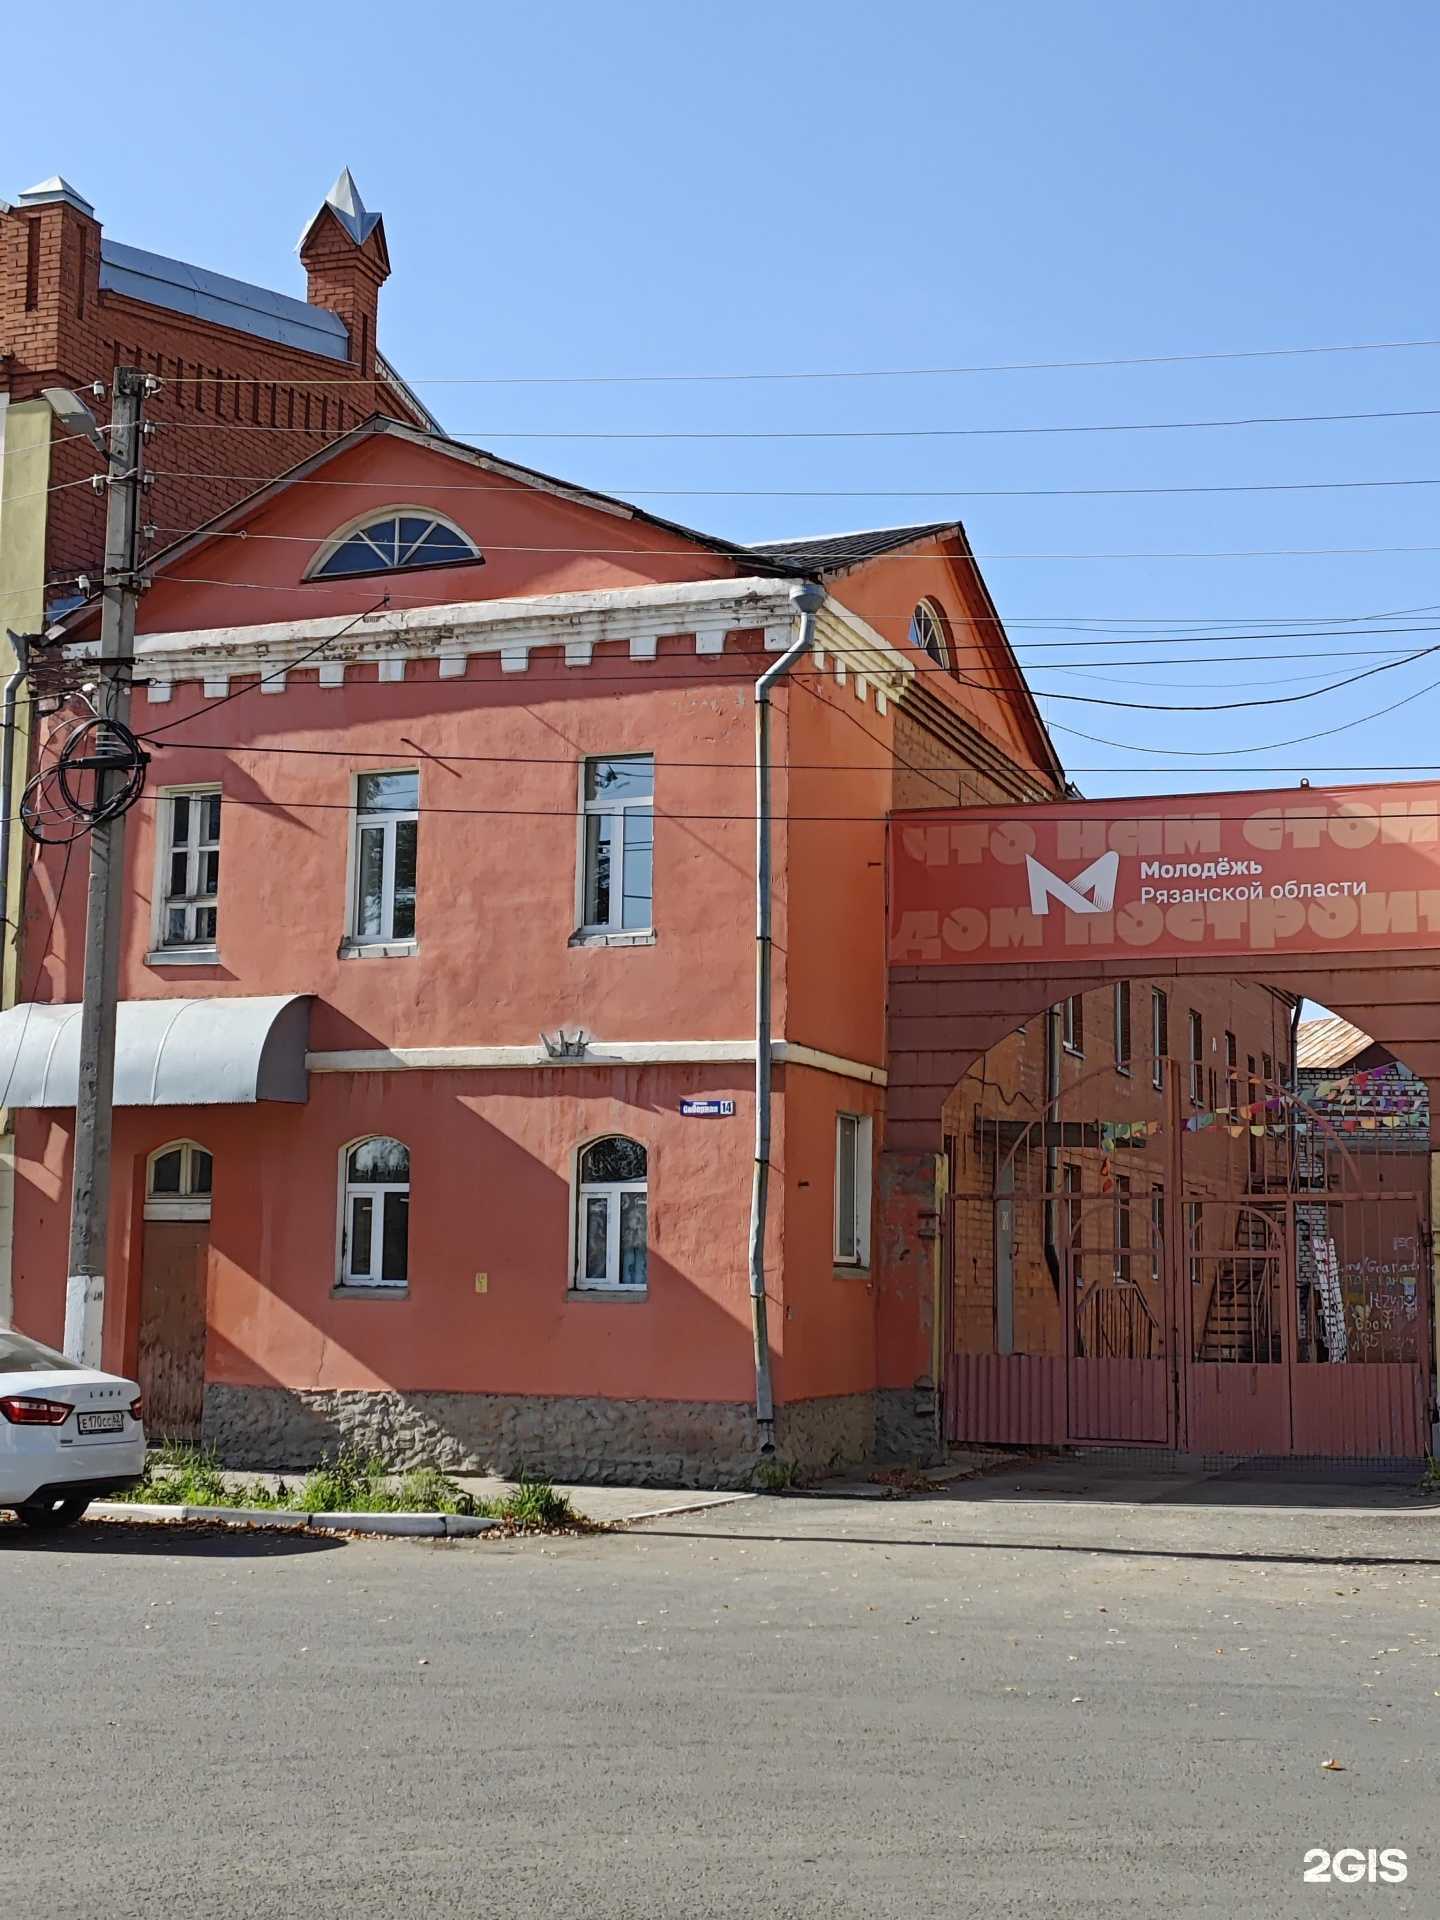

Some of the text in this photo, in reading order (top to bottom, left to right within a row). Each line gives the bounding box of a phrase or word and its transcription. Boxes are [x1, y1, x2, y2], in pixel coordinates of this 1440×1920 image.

[1140, 857, 1263, 880] Молодёжь
[1140, 879, 1368, 905] Рязанской области
[722, 1102, 732, 1113] 14
